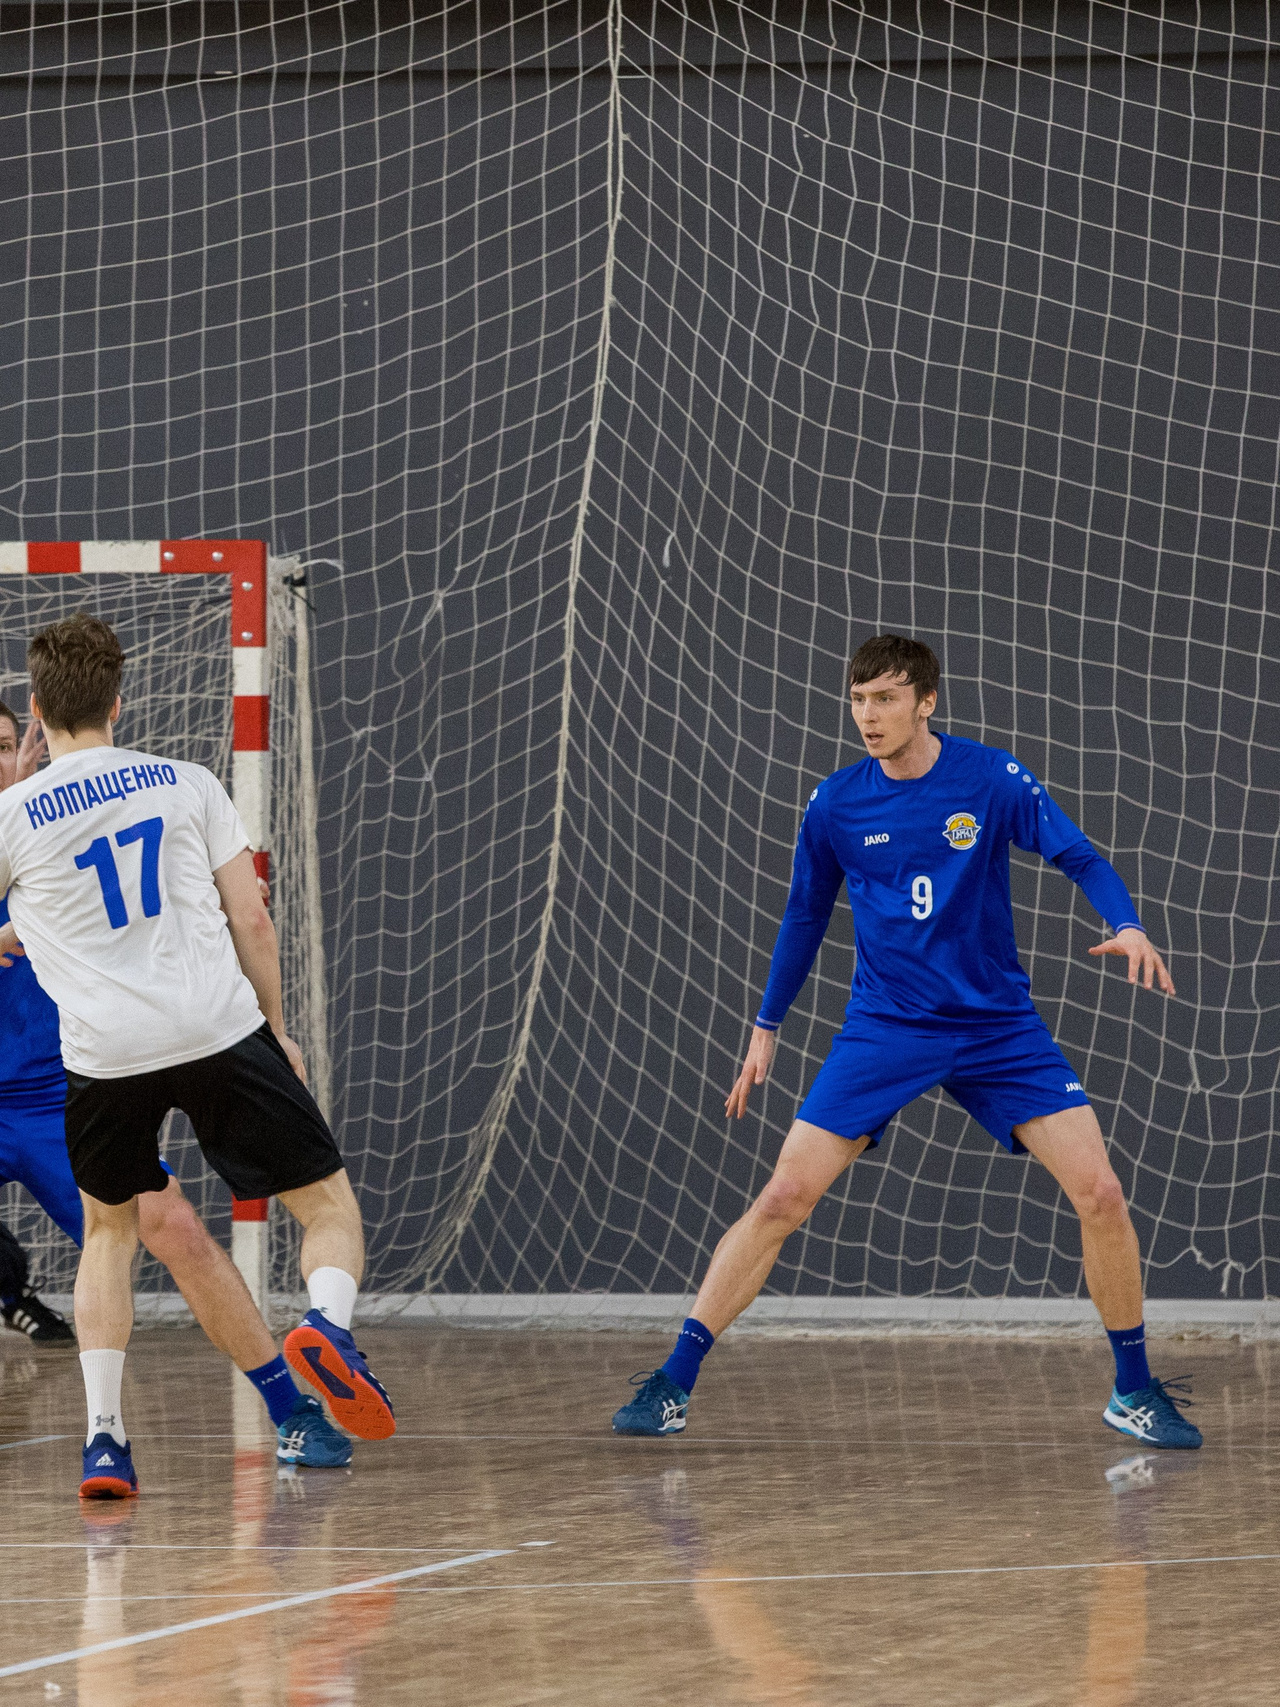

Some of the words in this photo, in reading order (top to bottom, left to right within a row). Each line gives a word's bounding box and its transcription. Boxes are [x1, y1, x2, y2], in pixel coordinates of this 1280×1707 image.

[24, 763, 178, 831] КОЛПАЩЕНКО
[863, 832, 890, 847] JAKO
[74, 816, 165, 930] 17
[911, 875, 933, 920] 9
